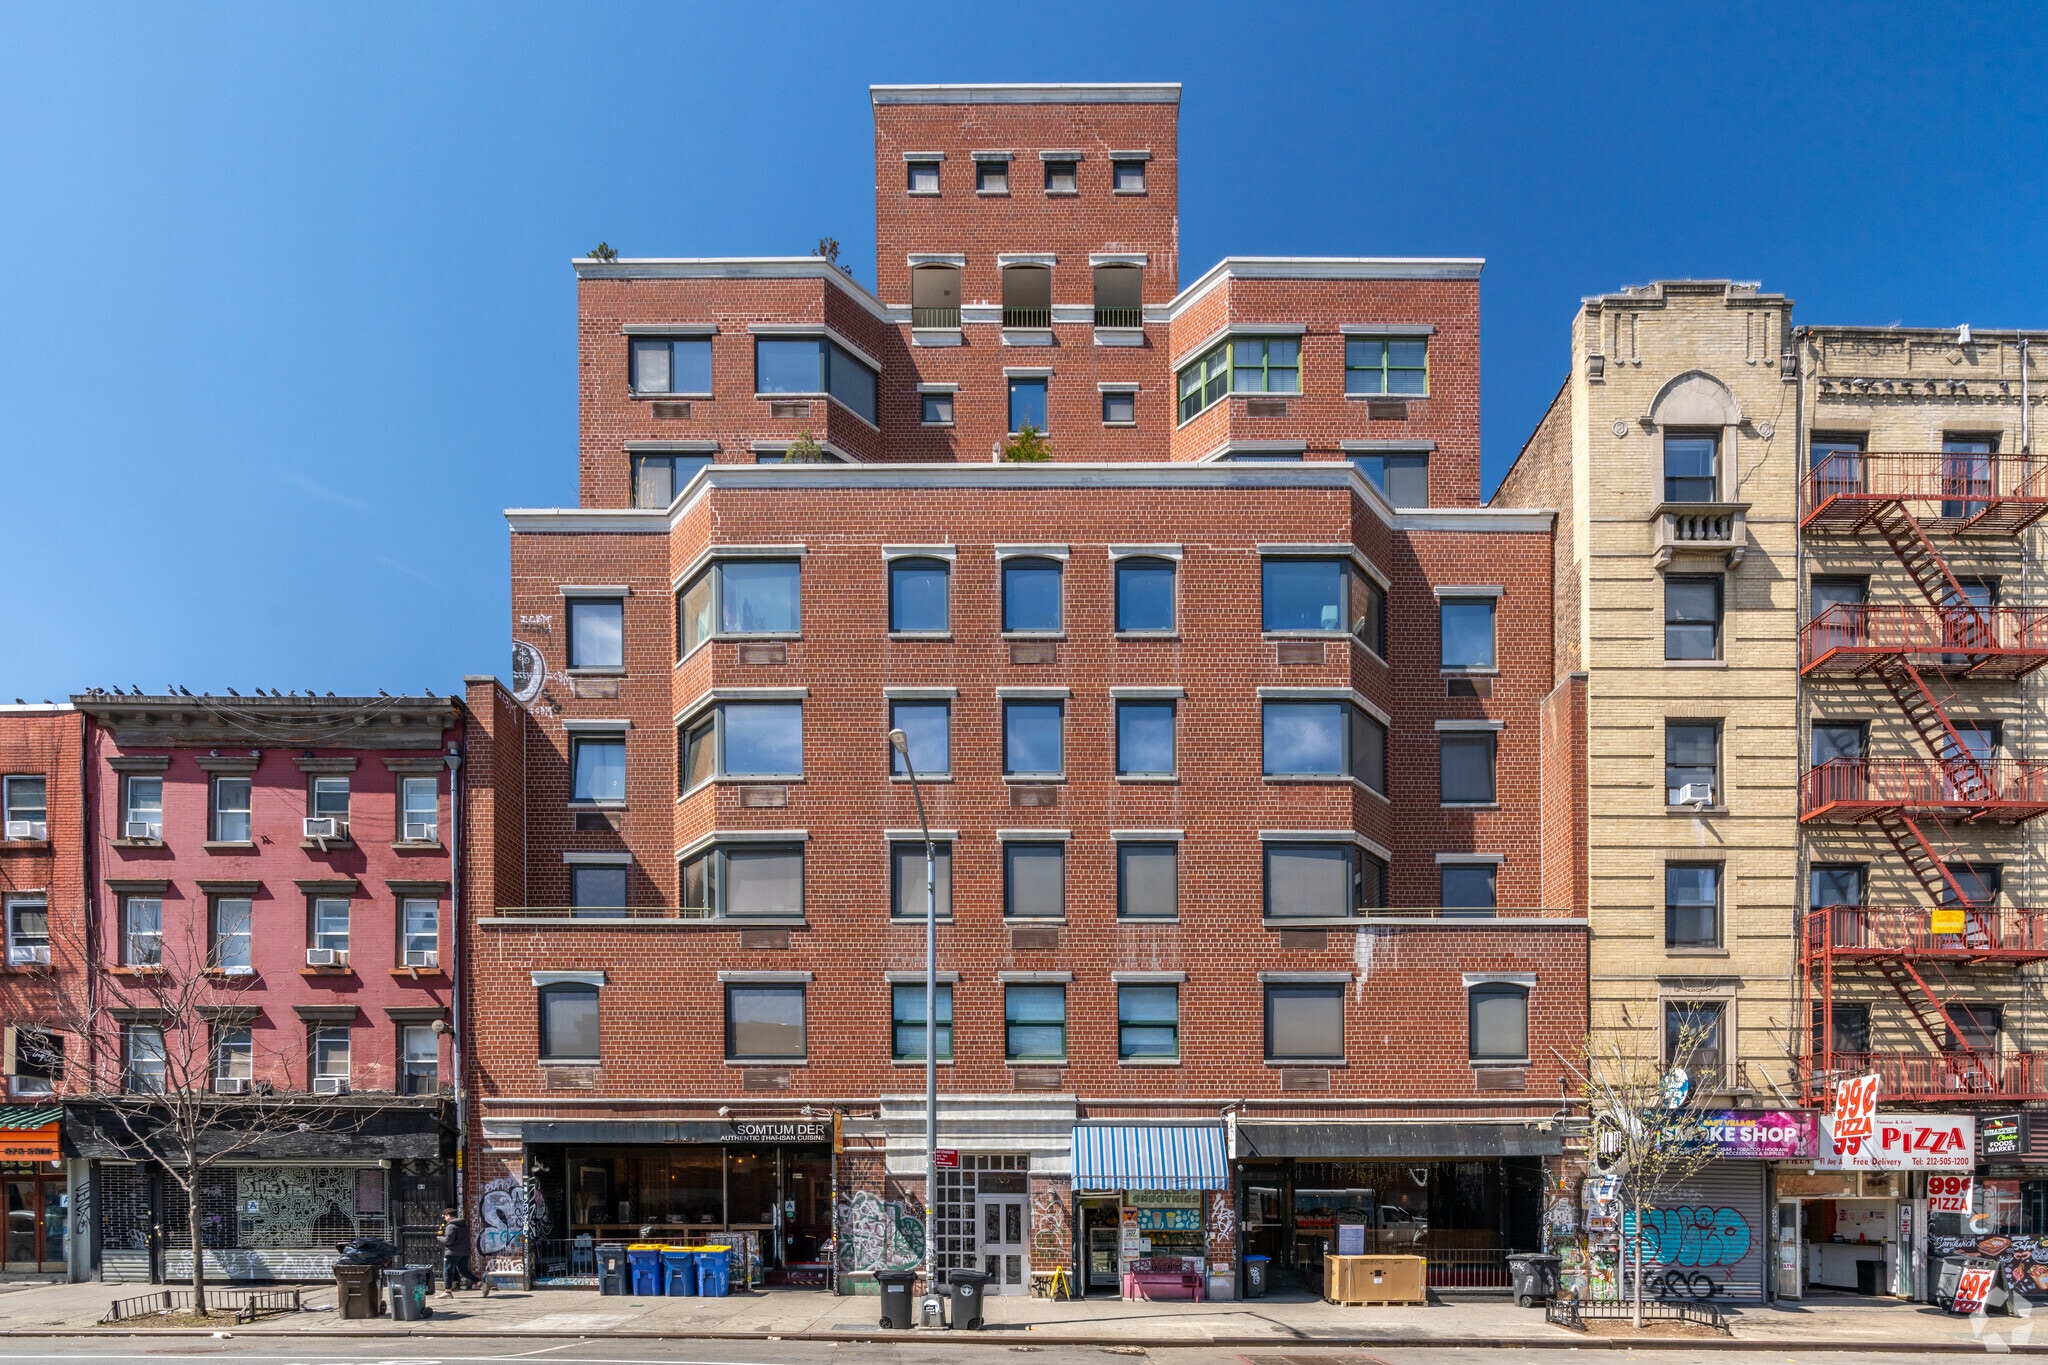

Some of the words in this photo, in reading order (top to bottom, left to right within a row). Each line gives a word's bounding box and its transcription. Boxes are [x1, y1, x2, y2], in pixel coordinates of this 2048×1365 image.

[1837, 1077, 1876, 1120] 99¢
[737, 1125, 794, 1135] SOMTUM
[797, 1125, 825, 1134] DER
[1834, 1117, 1872, 1137] PIZZA
[1740, 1126, 1797, 1142] SHOP
[1997, 1134, 2018, 1142] Choice
[1988, 1145, 2016, 1153] MARKET
[1989, 1140, 2013, 1148] FOODS
[1827, 1157, 1836, 1165] Ave
[1838, 1157, 1843, 1165] A
[1853, 1157, 1869, 1165] Free
[1872, 1157, 1902, 1166] Delivery
[1912, 1157, 1923, 1165] Tel:
[1926, 1157, 1969, 1165] 212-505-1200
[1928, 1176, 1972, 1196] 99¢
[1132, 1194, 1200, 1203] SMOOTHIES
[1929, 1197, 1969, 1211] PIZZA
[1903, 1207, 1910, 1216] A
[1935, 1237, 1976, 1248] Sandwich
[2013, 1241, 2038, 1251] Salad
[1958, 1274, 1991, 1300] 99¢
